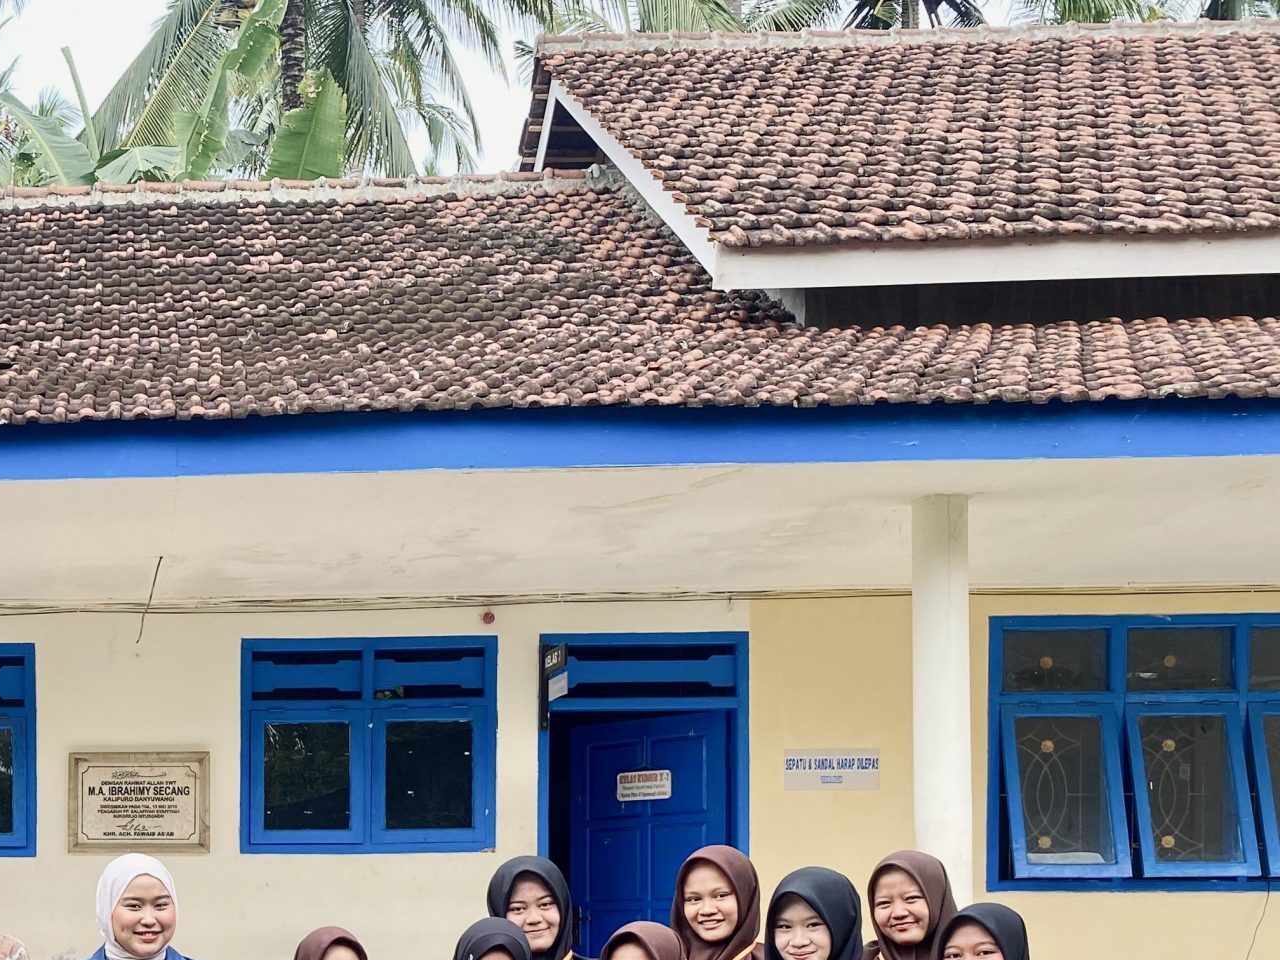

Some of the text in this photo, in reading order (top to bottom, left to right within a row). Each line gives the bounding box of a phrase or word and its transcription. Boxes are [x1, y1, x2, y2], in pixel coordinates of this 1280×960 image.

[786, 758, 807, 770] SEPATU
[814, 758, 835, 770] SANDAL
[837, 758, 855, 770] HARAP
[857, 758, 879, 770] DILEPAS
[88, 786, 190, 796] M.A. IBRAHIMY SECANG
